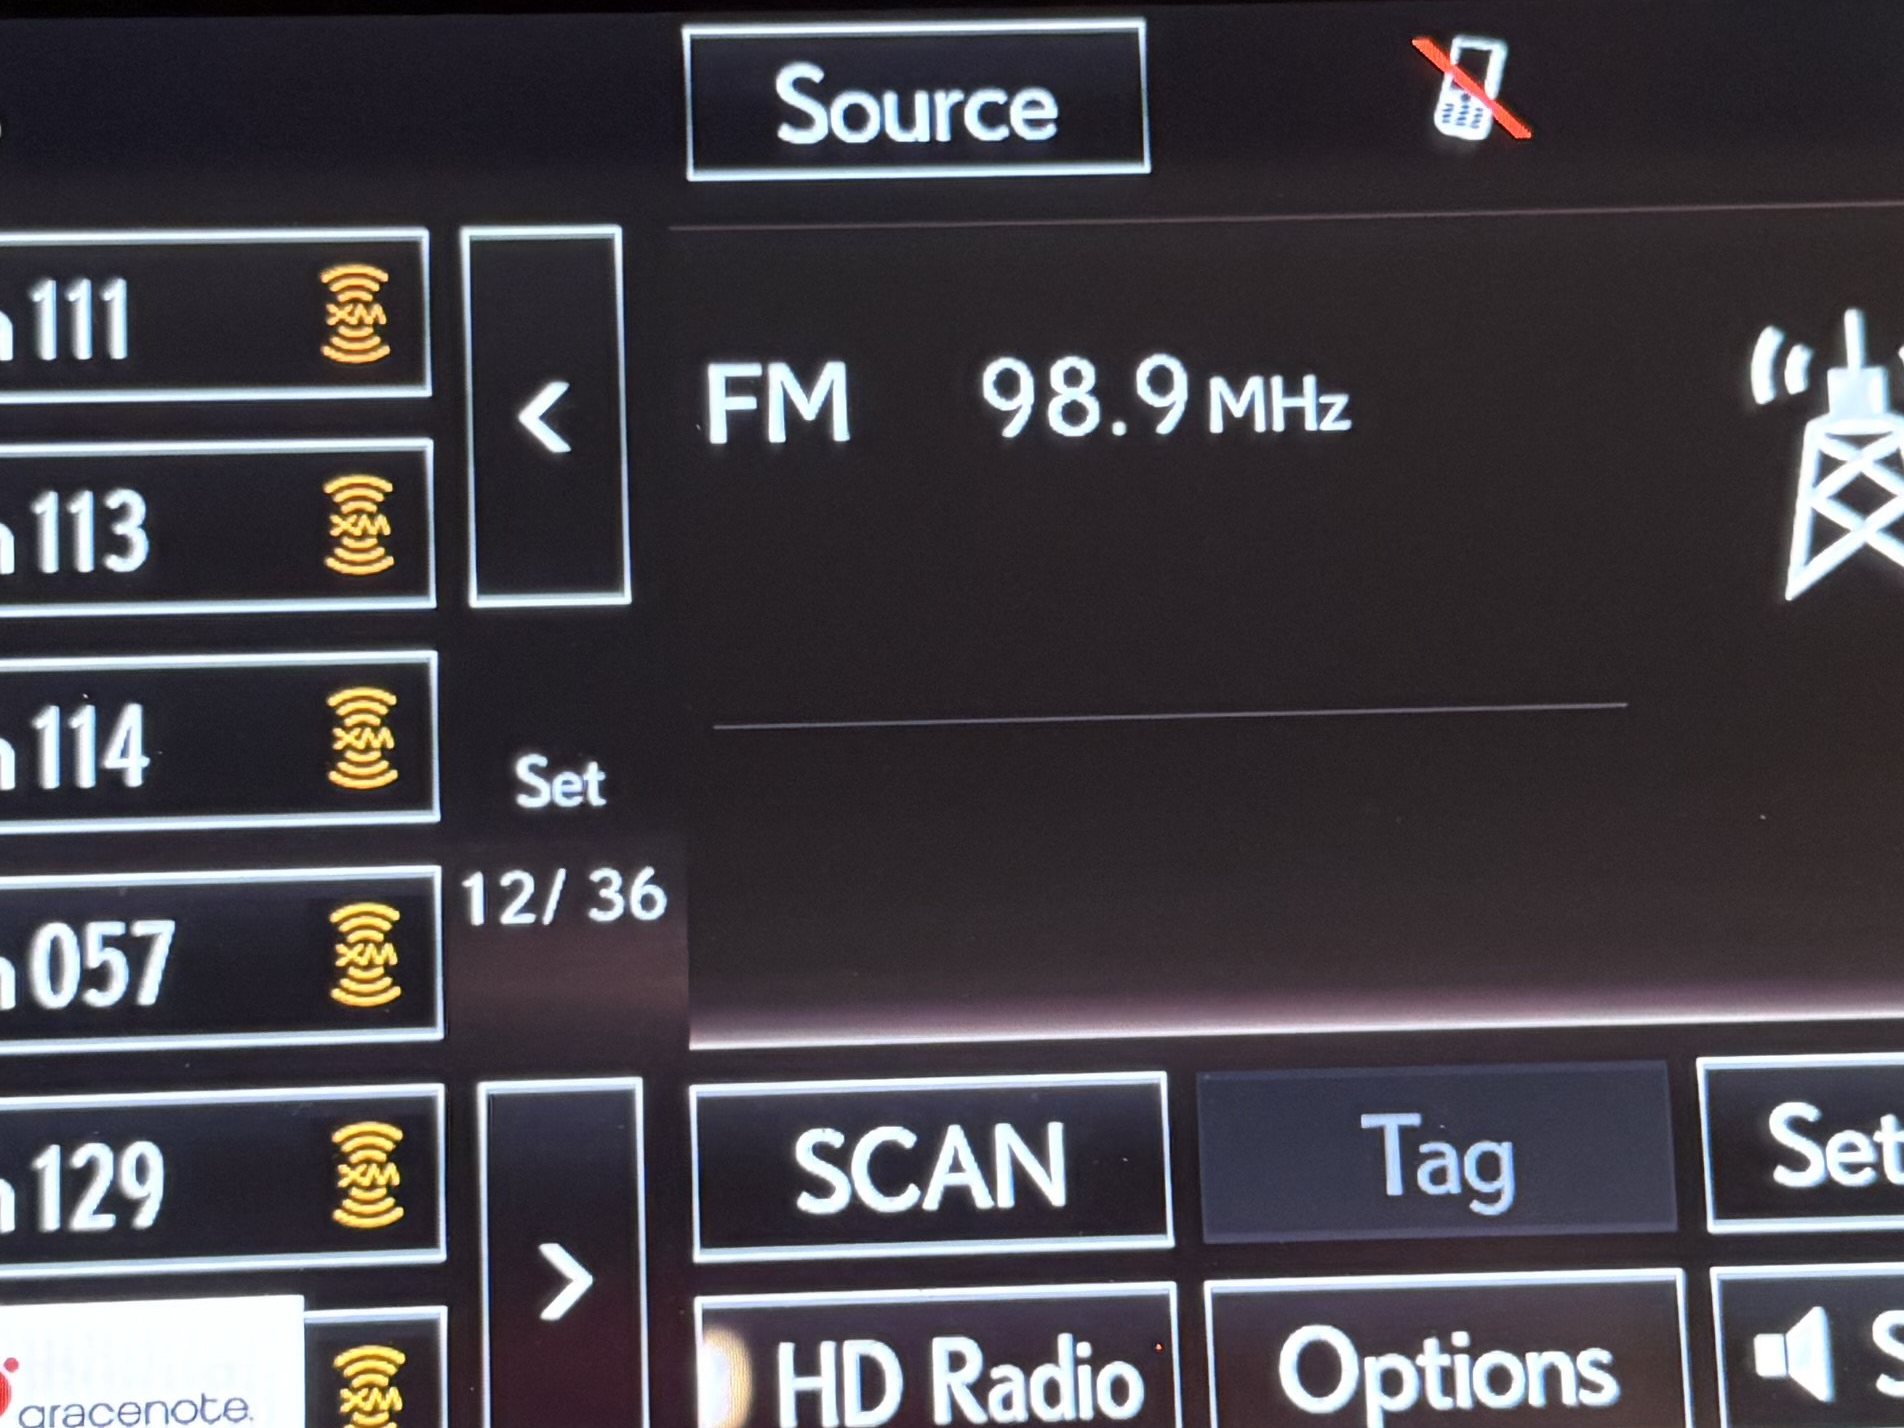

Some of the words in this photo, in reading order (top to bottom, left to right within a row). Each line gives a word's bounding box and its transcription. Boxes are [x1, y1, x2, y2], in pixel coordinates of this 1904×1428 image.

[774, 60, 1061, 146] Source
[705, 359, 852, 446] FM
[980, 351, 1190, 440] 98.9
[1207, 373, 1353, 435] MHz
[513, 751, 608, 810] Set
[793, 1119, 1068, 1216] SCAN
[1359, 1111, 1517, 1217] Tag
[929, 1331, 1146, 1427] Radio
